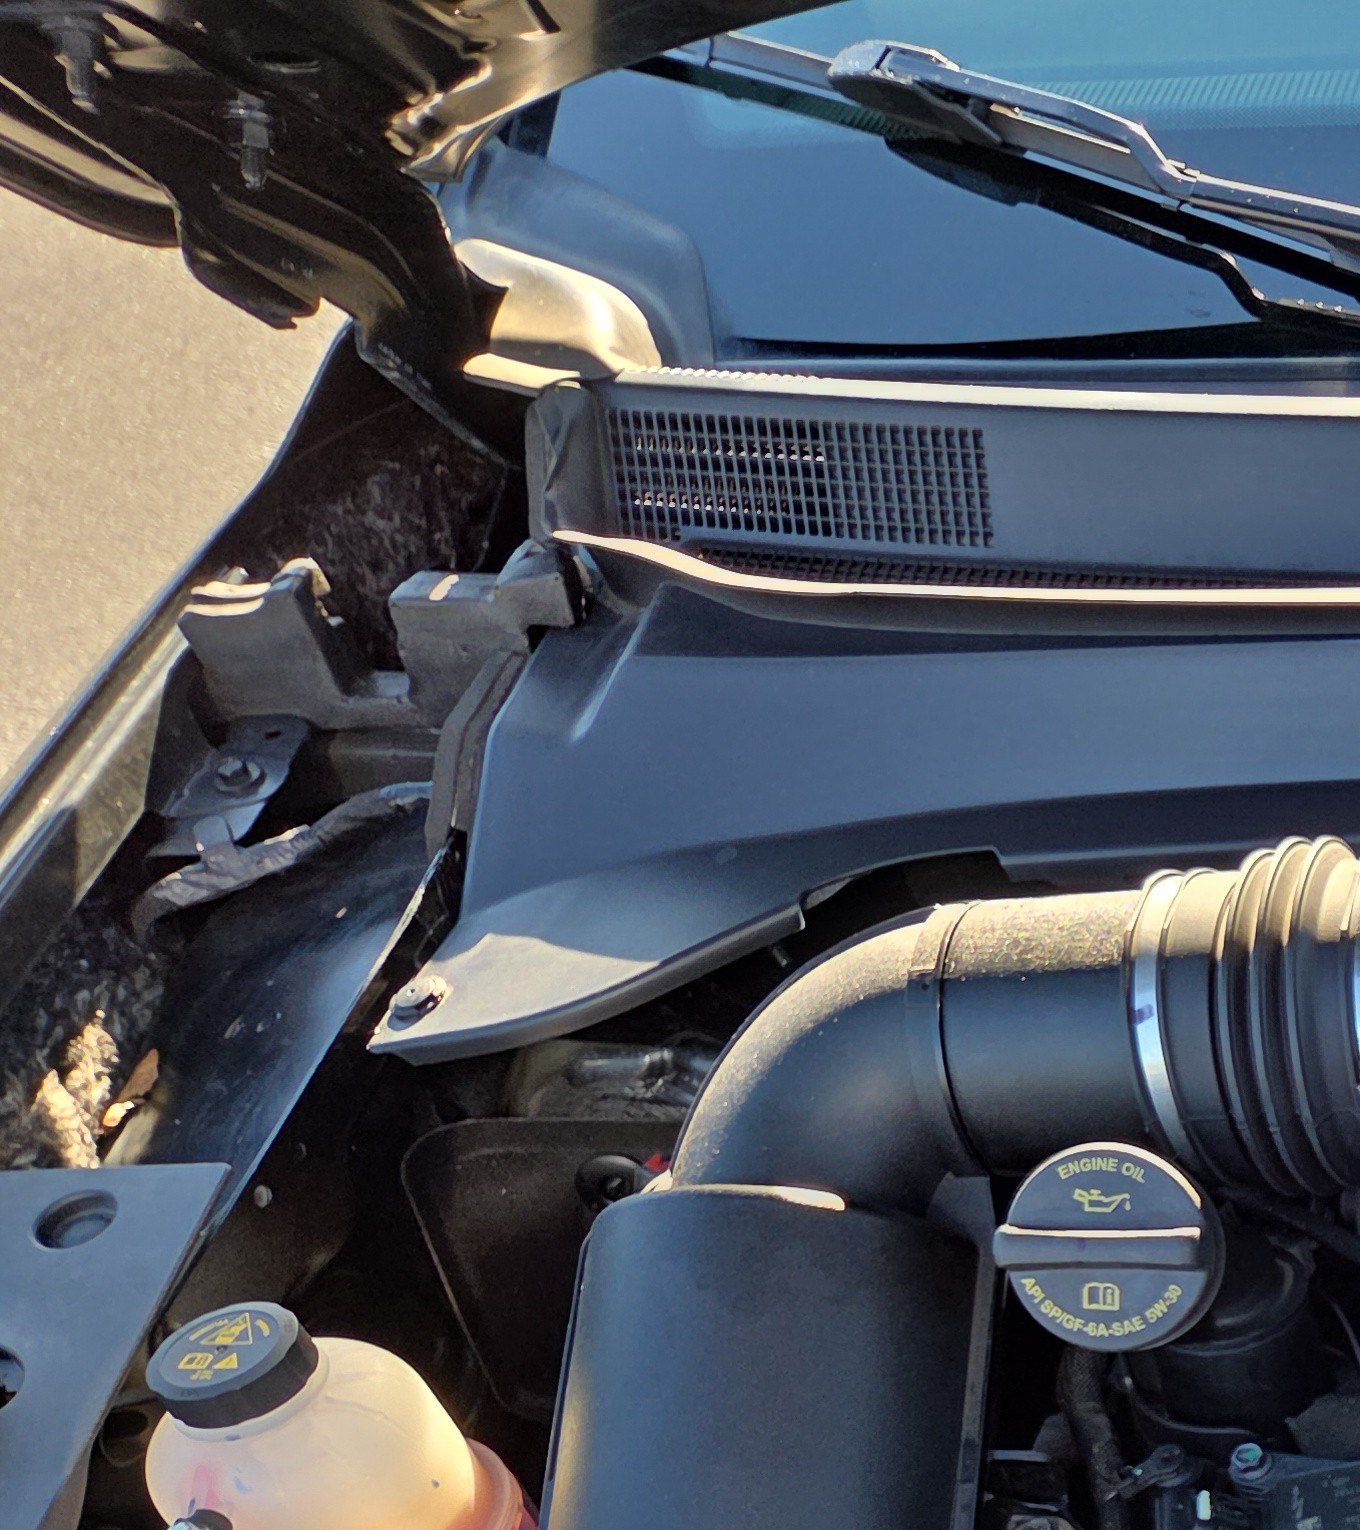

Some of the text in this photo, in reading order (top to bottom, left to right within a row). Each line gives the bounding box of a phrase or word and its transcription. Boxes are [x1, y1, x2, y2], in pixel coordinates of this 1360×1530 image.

[1057, 1157, 1147, 1184] ENGINE OIL
[1020, 1276, 1045, 1304] API
[1144, 1283, 1184, 1324] 5W-30
